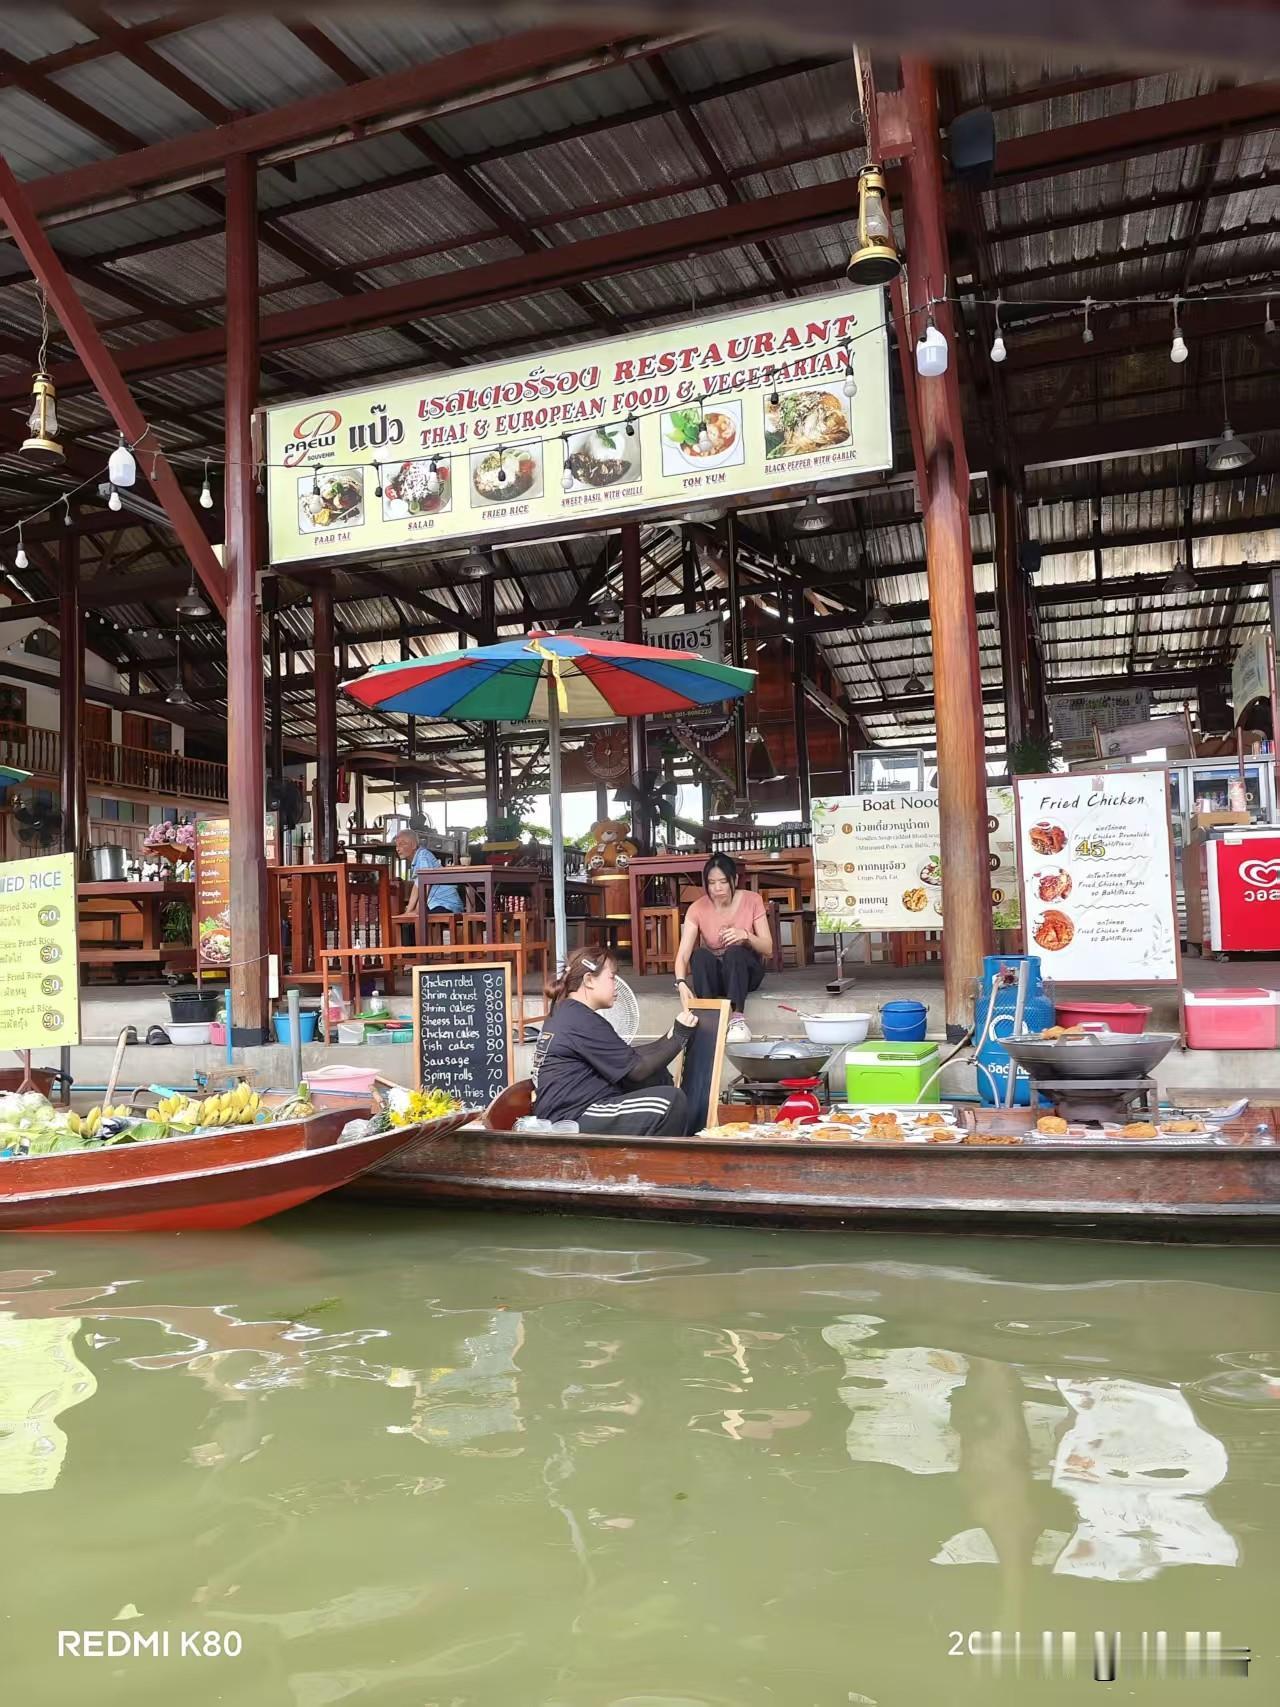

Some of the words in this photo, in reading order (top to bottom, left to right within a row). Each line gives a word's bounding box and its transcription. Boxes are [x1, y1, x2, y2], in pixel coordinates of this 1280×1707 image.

[614, 314, 858, 383] RESTAURANT
[420, 422, 468, 449] THAI
[473, 418, 491, 440] &
[495, 398, 604, 434] EUROPEAN
[612, 383, 669, 414] FOOD
[677, 380, 696, 401] &
[702, 349, 855, 397] VEGETARIAN
[349, 404, 404, 452] แป๊ว
[285, 435, 336, 454] PAEW
[307, 451, 335, 462] SOUVENIR
[764, 463, 786, 474] BLACK
[787, 458, 811, 470] PEPPER
[813, 454, 831, 466] WITH
[832, 450, 858, 463] GARLIC
[682, 478, 701, 488] TOM
[705, 472, 727, 485] YUM
[561, 495, 582, 507] SWEET
[583, 493, 601, 505] BASIL
[603, 490, 620, 501] WITH
[482, 508, 507, 520] FRIED
[509, 504, 529, 516] RICE
[407, 519, 434, 531] SALAD
[862, 798, 895, 812] Boat
[1040, 795, 1080, 810] Fried
[1087, 791, 1145, 807] Chicken
[1075, 839, 1106, 858] 45
[0, 876, 24, 893] IED
[30, 871, 62, 889] RICE
[421, 975, 453, 989] Chicken
[482, 973, 503, 988] 80
[421, 988, 448, 1001] Shrim
[484, 988, 503, 1001] 80
[422, 1002, 446, 1013] Shrim
[449, 1001, 476, 1013] cakes
[485, 1000, 503, 1011] 80
[485, 1011, 504, 1024] 80
[421, 1027, 454, 1039] Chicken
[456, 1026, 480, 1039] cakes
[486, 1024, 502, 1037] 80
[422, 1039, 442, 1051] Fish
[448, 1040, 475, 1051] cakes
[486, 1038, 504, 1051] 80
[423, 1053, 470, 1068] Sausage
[486, 1053, 504, 1065] 70
[424, 1069, 451, 1086] Sping
[454, 1067, 473, 1081] rolls
[487, 1068, 503, 1080] 70
[463, 1085, 484, 1098] fries
